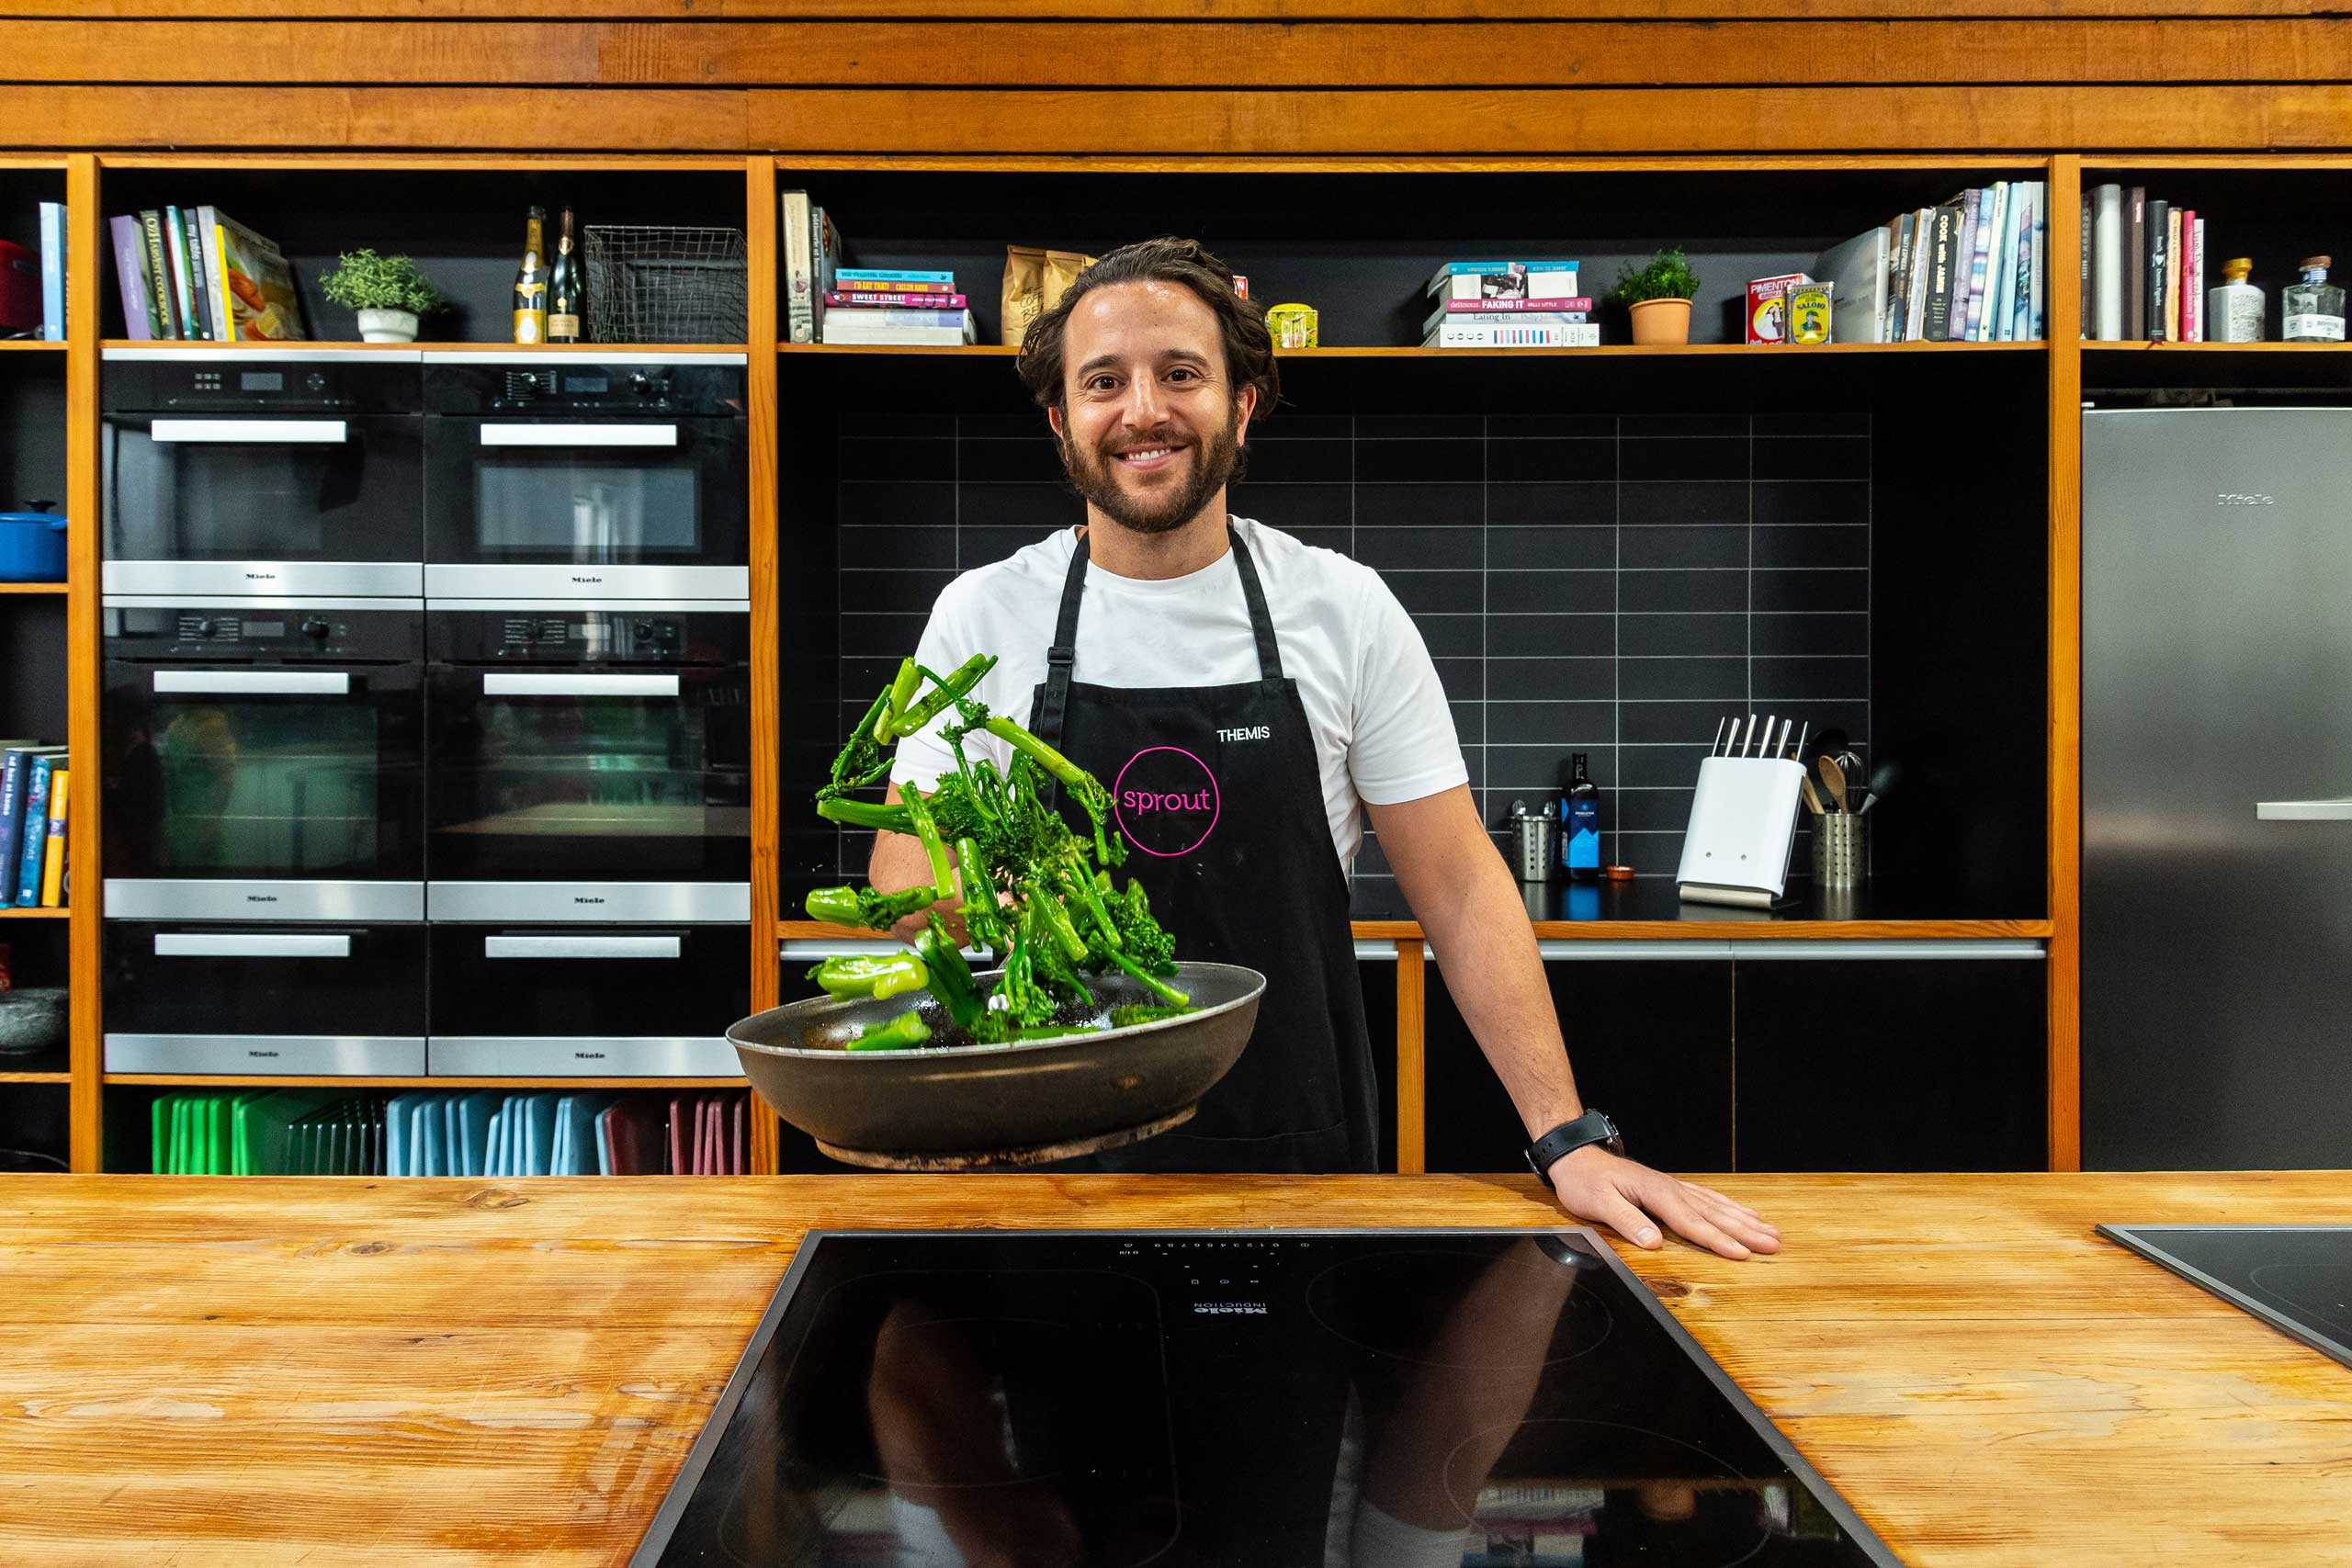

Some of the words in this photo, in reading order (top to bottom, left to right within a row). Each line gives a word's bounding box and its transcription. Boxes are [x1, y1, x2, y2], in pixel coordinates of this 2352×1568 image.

[1939, 214, 1950, 243] COOK
[1937, 243, 1947, 264] with
[1482, 300, 1514, 309] FAKING
[1515, 300, 1524, 309] IT
[1473, 312, 1499, 321] Eating
[1216, 727, 1271, 742] THEMIS
[1124, 789, 1211, 816] sprout
